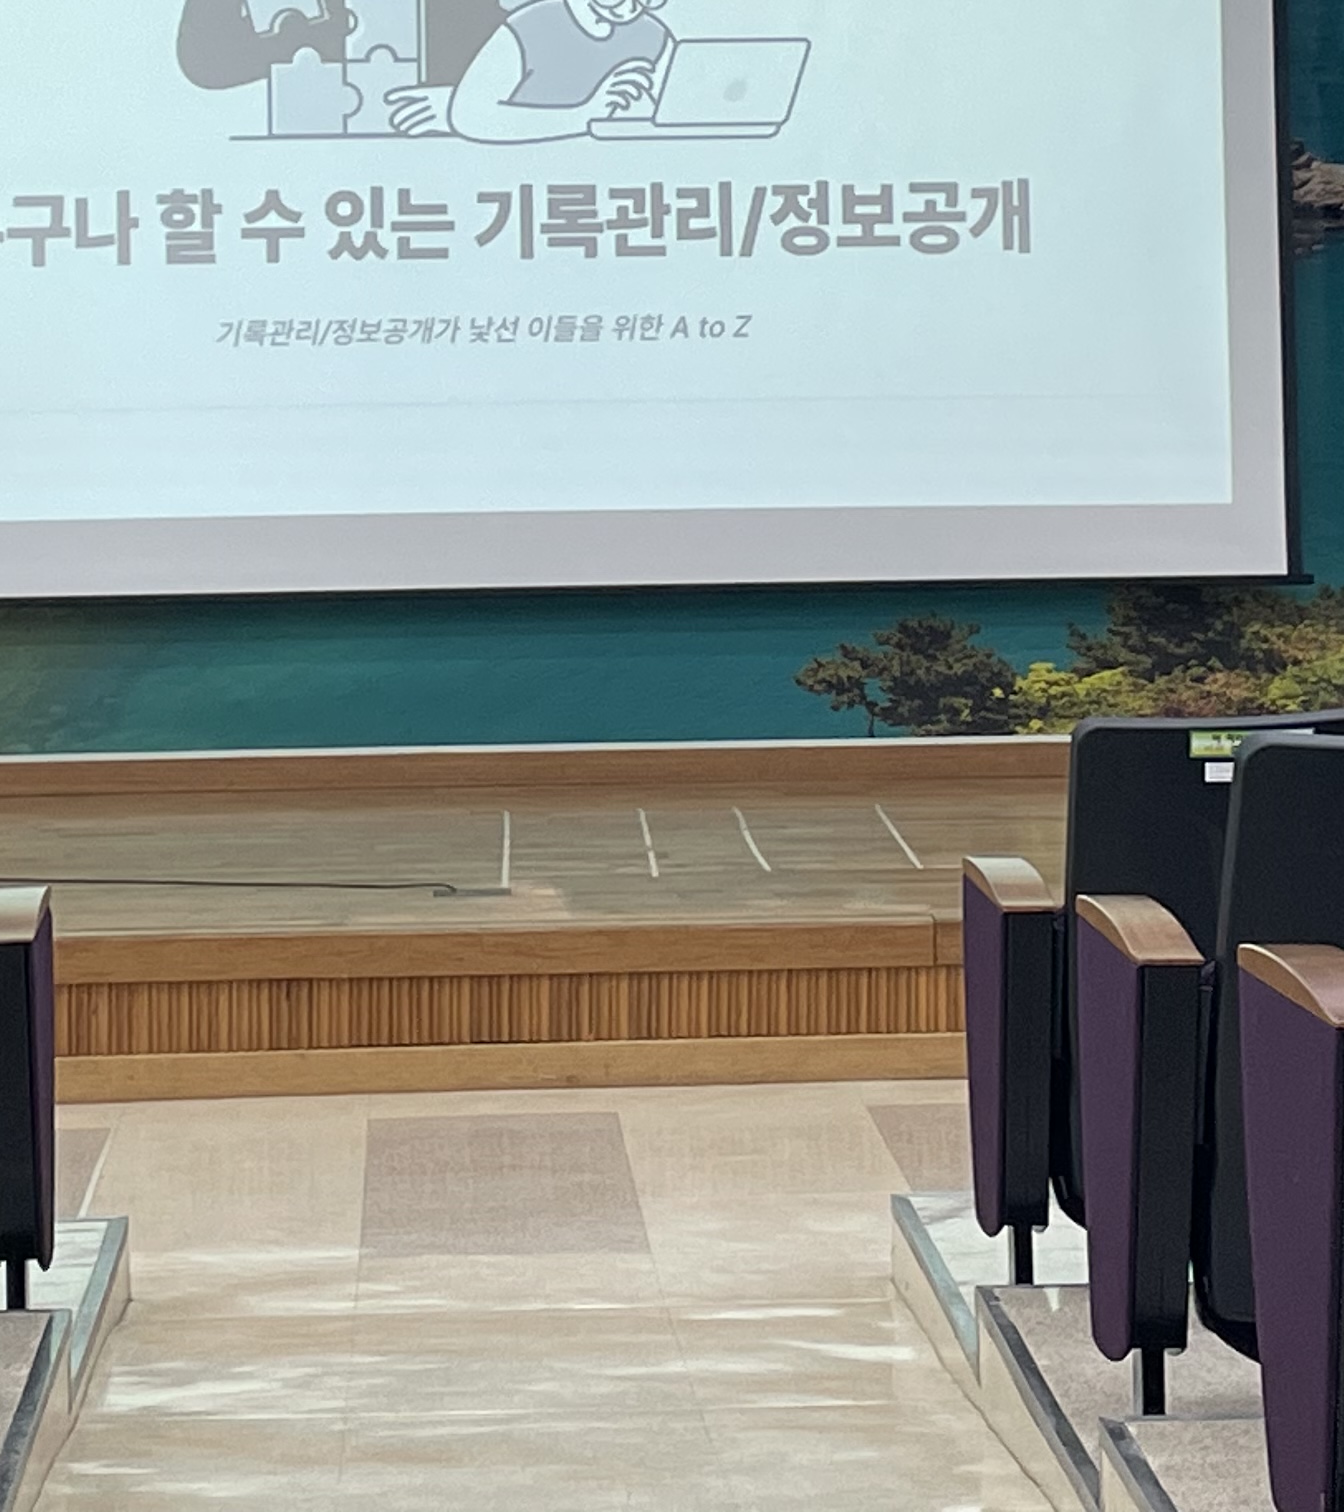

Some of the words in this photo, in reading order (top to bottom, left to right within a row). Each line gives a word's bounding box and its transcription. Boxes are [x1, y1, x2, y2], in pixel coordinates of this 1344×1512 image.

[155, 188, 223, 265] 할
[240, 189, 306, 263] 수
[324, 186, 456, 261] 있는
[473, 178, 1032, 260] 기록관리/정보공개
[215, 315, 461, 348] 기록관리/정보공개가
[468, 315, 520, 344] 낯선
[527, 314, 604, 343] 이들을
[611, 312, 665, 342] 위한
[669, 315, 690, 339] A
[698, 315, 726, 339] to
[732, 314, 753, 338] Z
